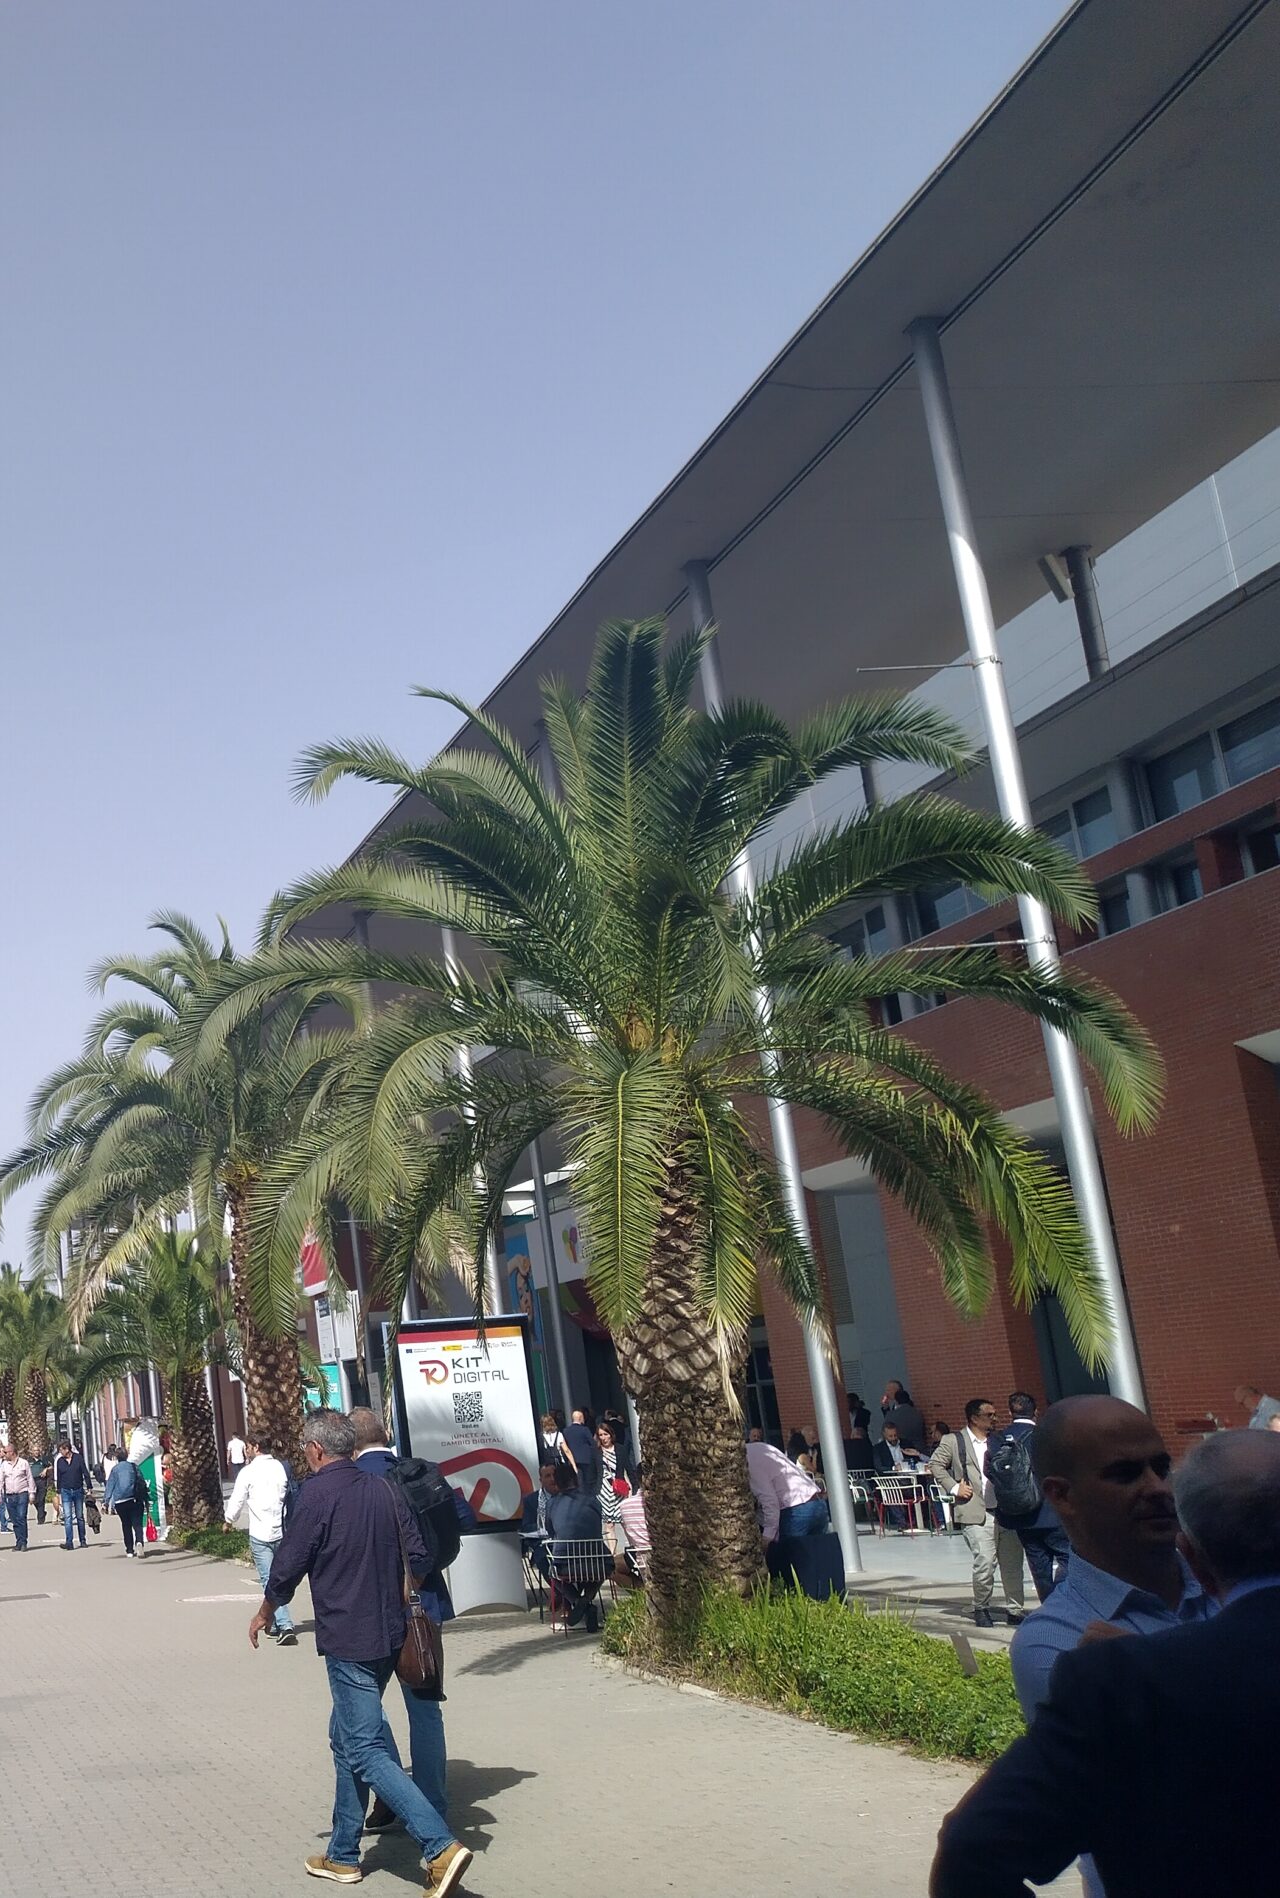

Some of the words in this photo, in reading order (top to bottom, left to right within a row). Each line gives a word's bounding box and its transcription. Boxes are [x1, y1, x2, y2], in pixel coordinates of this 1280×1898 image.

[452, 1356, 483, 1369] KIT
[453, 1369, 510, 1384] DIGITAL
[440, 1439, 471, 1447] CAMBIO
[472, 1437, 504, 1445] DIGITAL!
